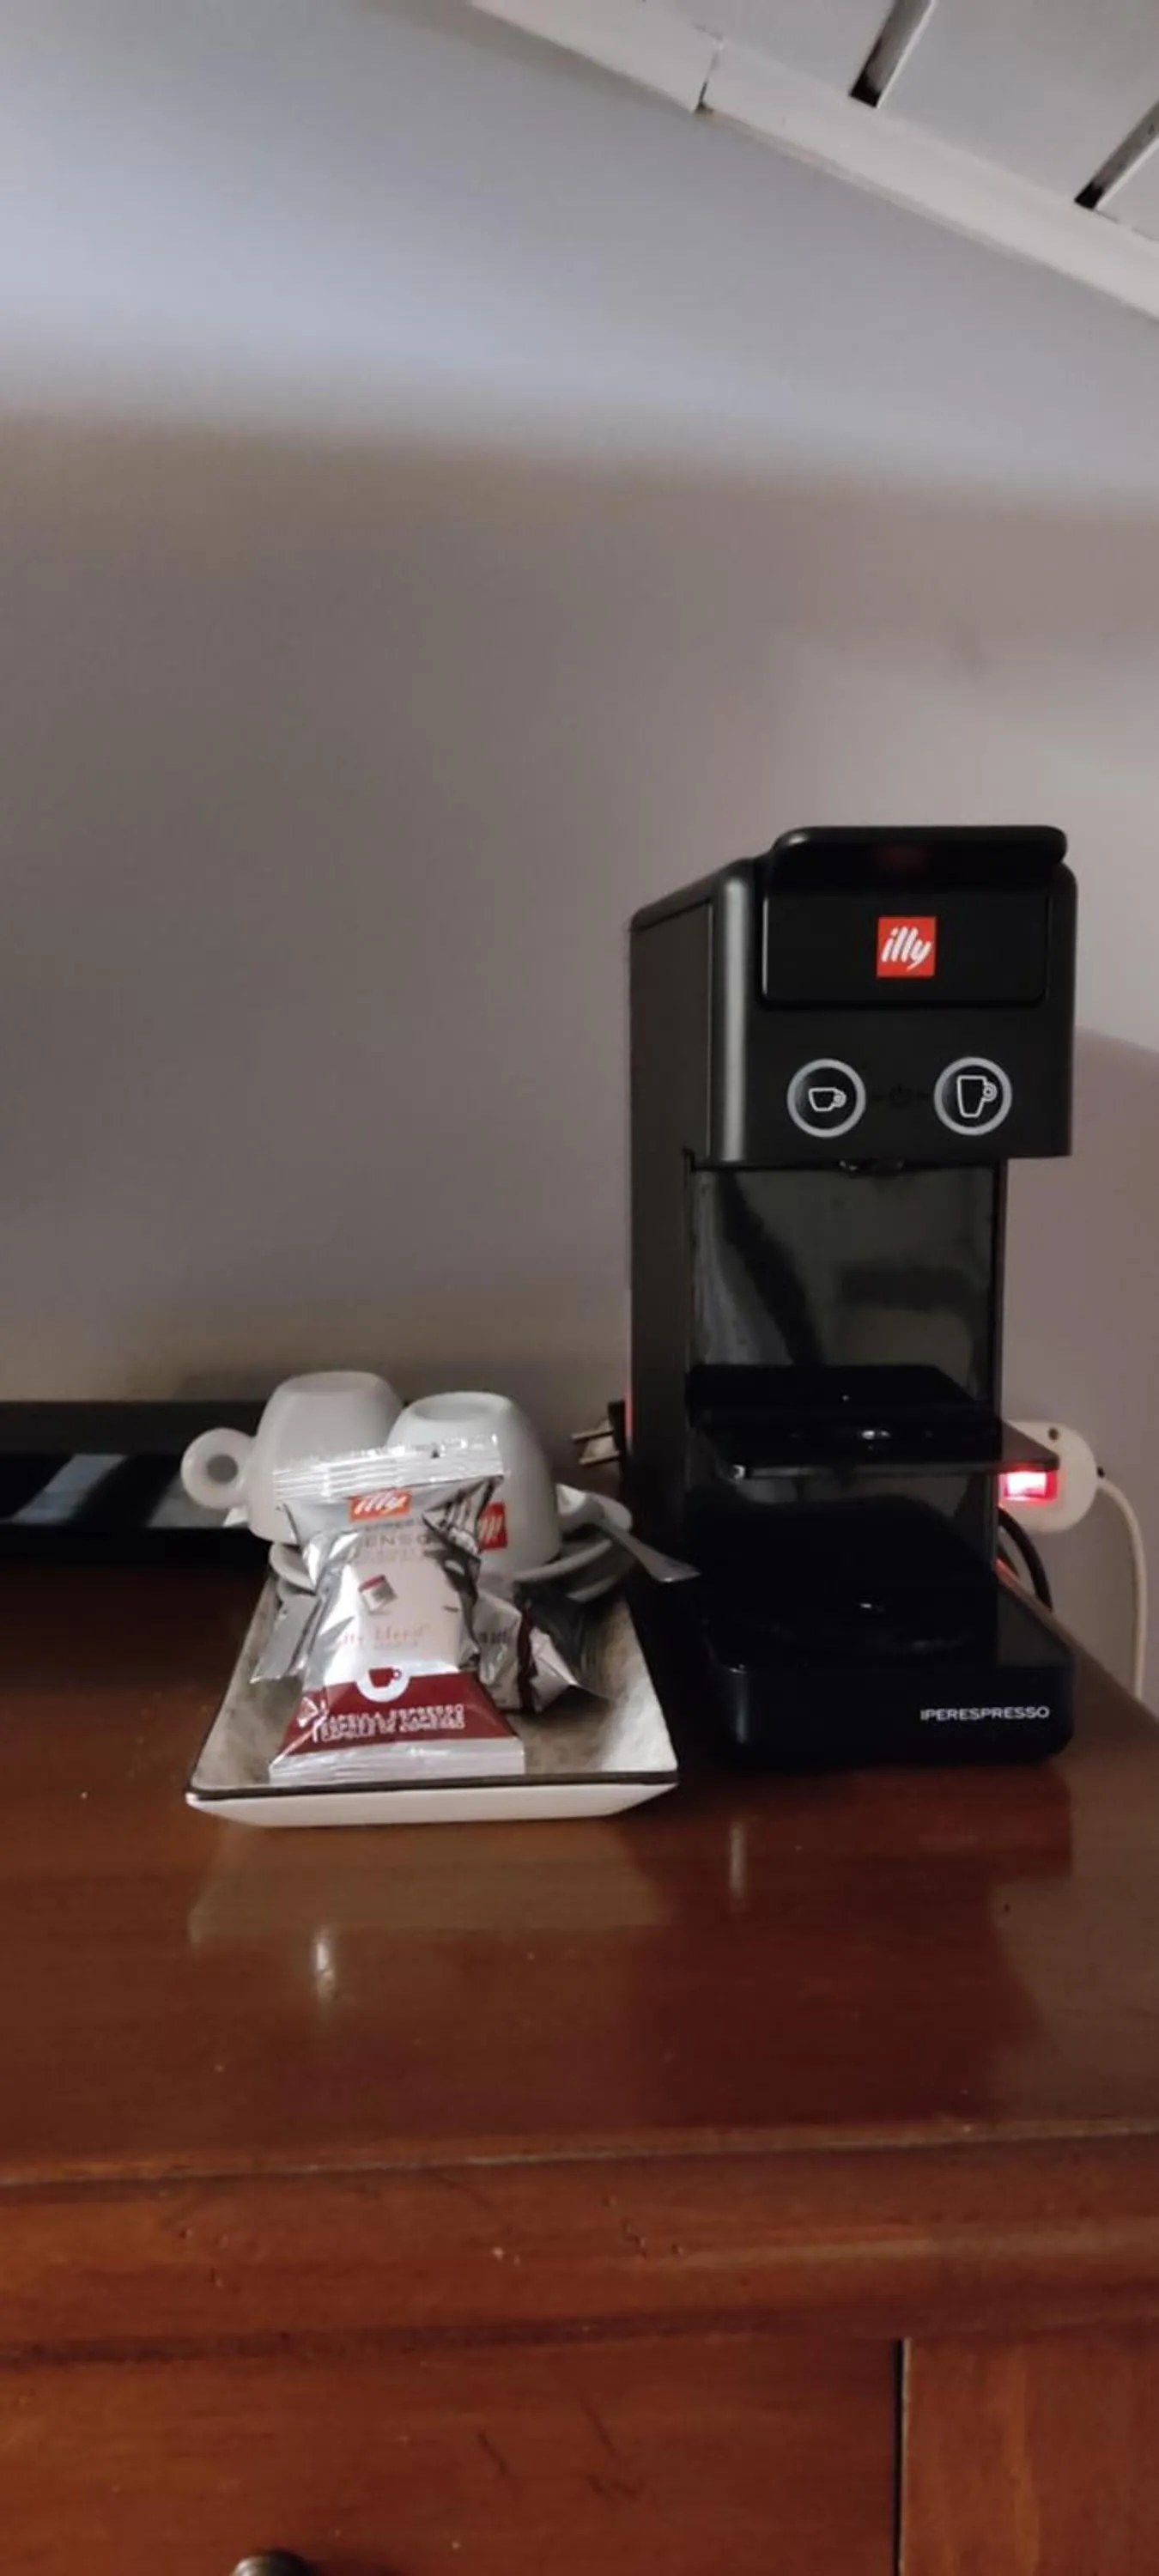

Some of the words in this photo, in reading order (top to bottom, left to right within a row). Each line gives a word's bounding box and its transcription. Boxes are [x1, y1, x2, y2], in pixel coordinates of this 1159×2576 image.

[882, 927, 931, 972] illy
[354, 1490, 408, 1515] illy
[919, 1705, 1051, 1722] IPERESPRESSO
